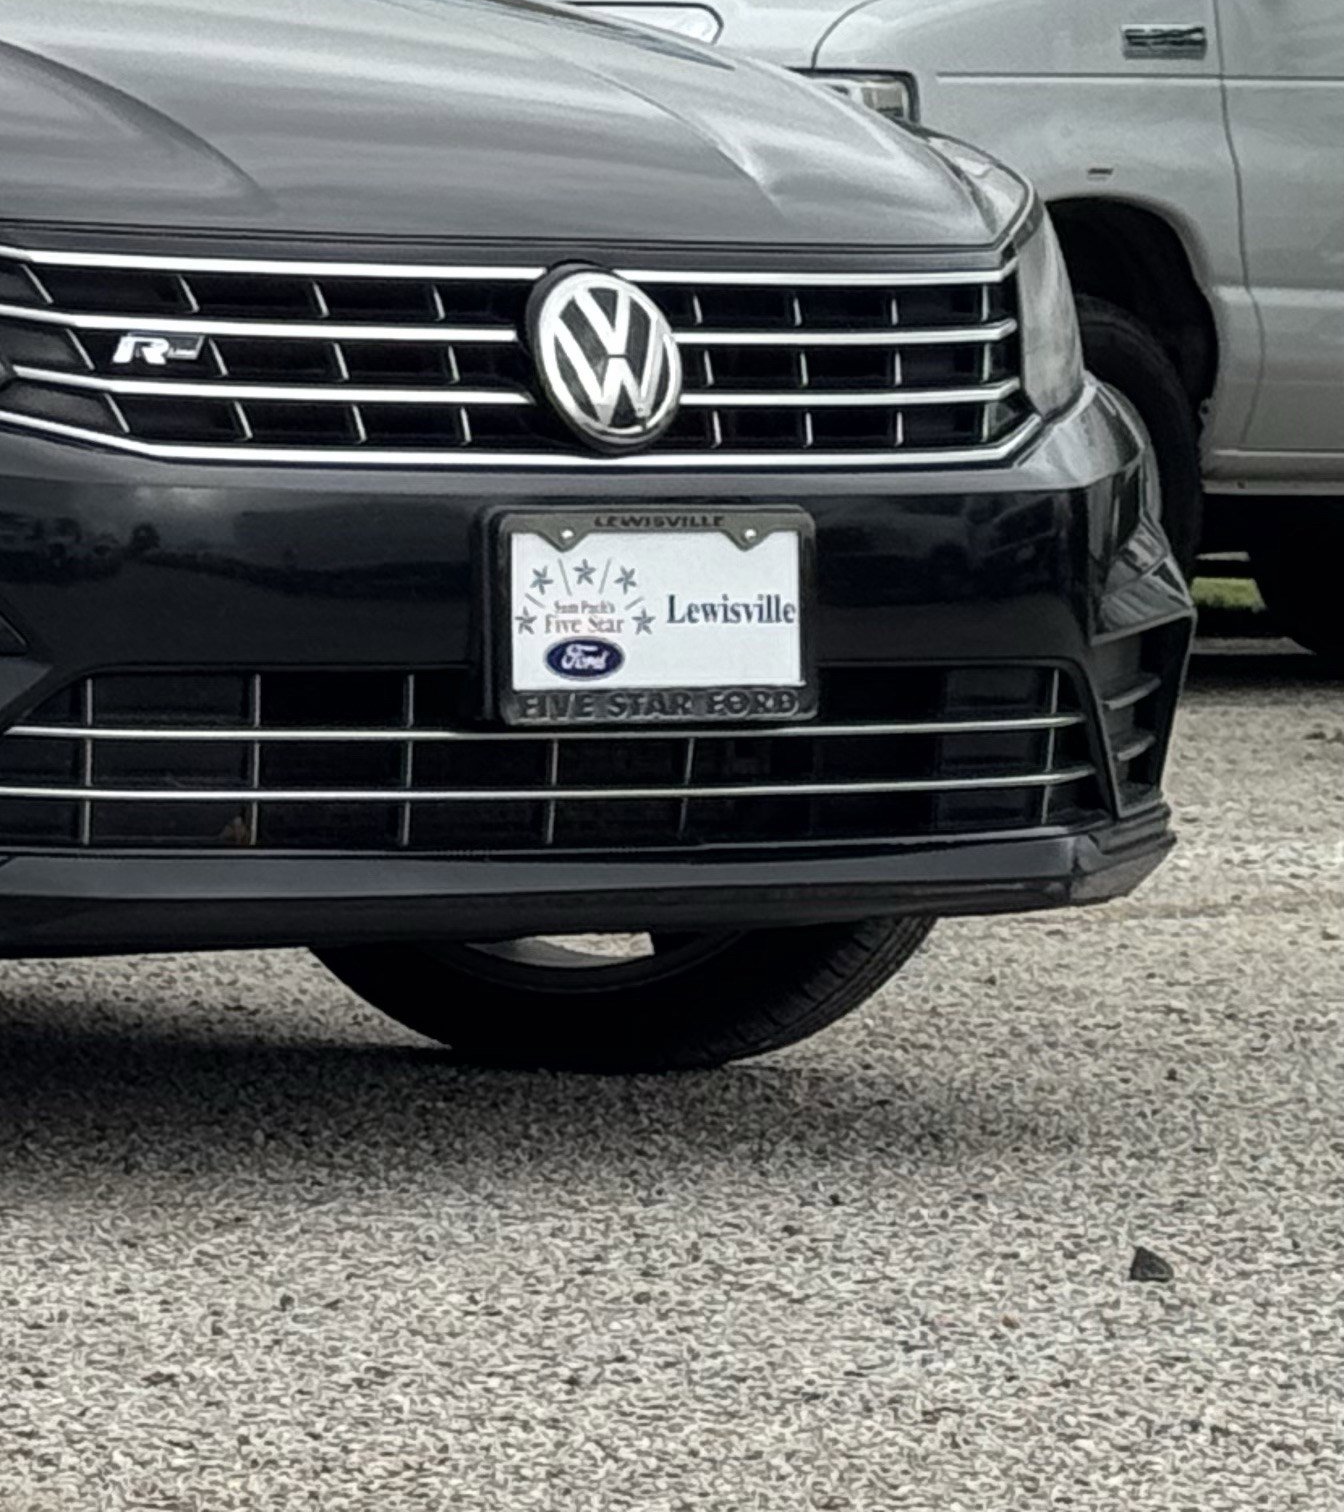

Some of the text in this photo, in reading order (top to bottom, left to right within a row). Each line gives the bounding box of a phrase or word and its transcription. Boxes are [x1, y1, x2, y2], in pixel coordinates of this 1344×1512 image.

[593, 515, 725, 529] LEWISVILLE
[666, 593, 797, 625] Lewisville
[544, 614, 625, 634] Five Star
[560, 643, 611, 670] Ford
[607, 691, 695, 718] STAR
